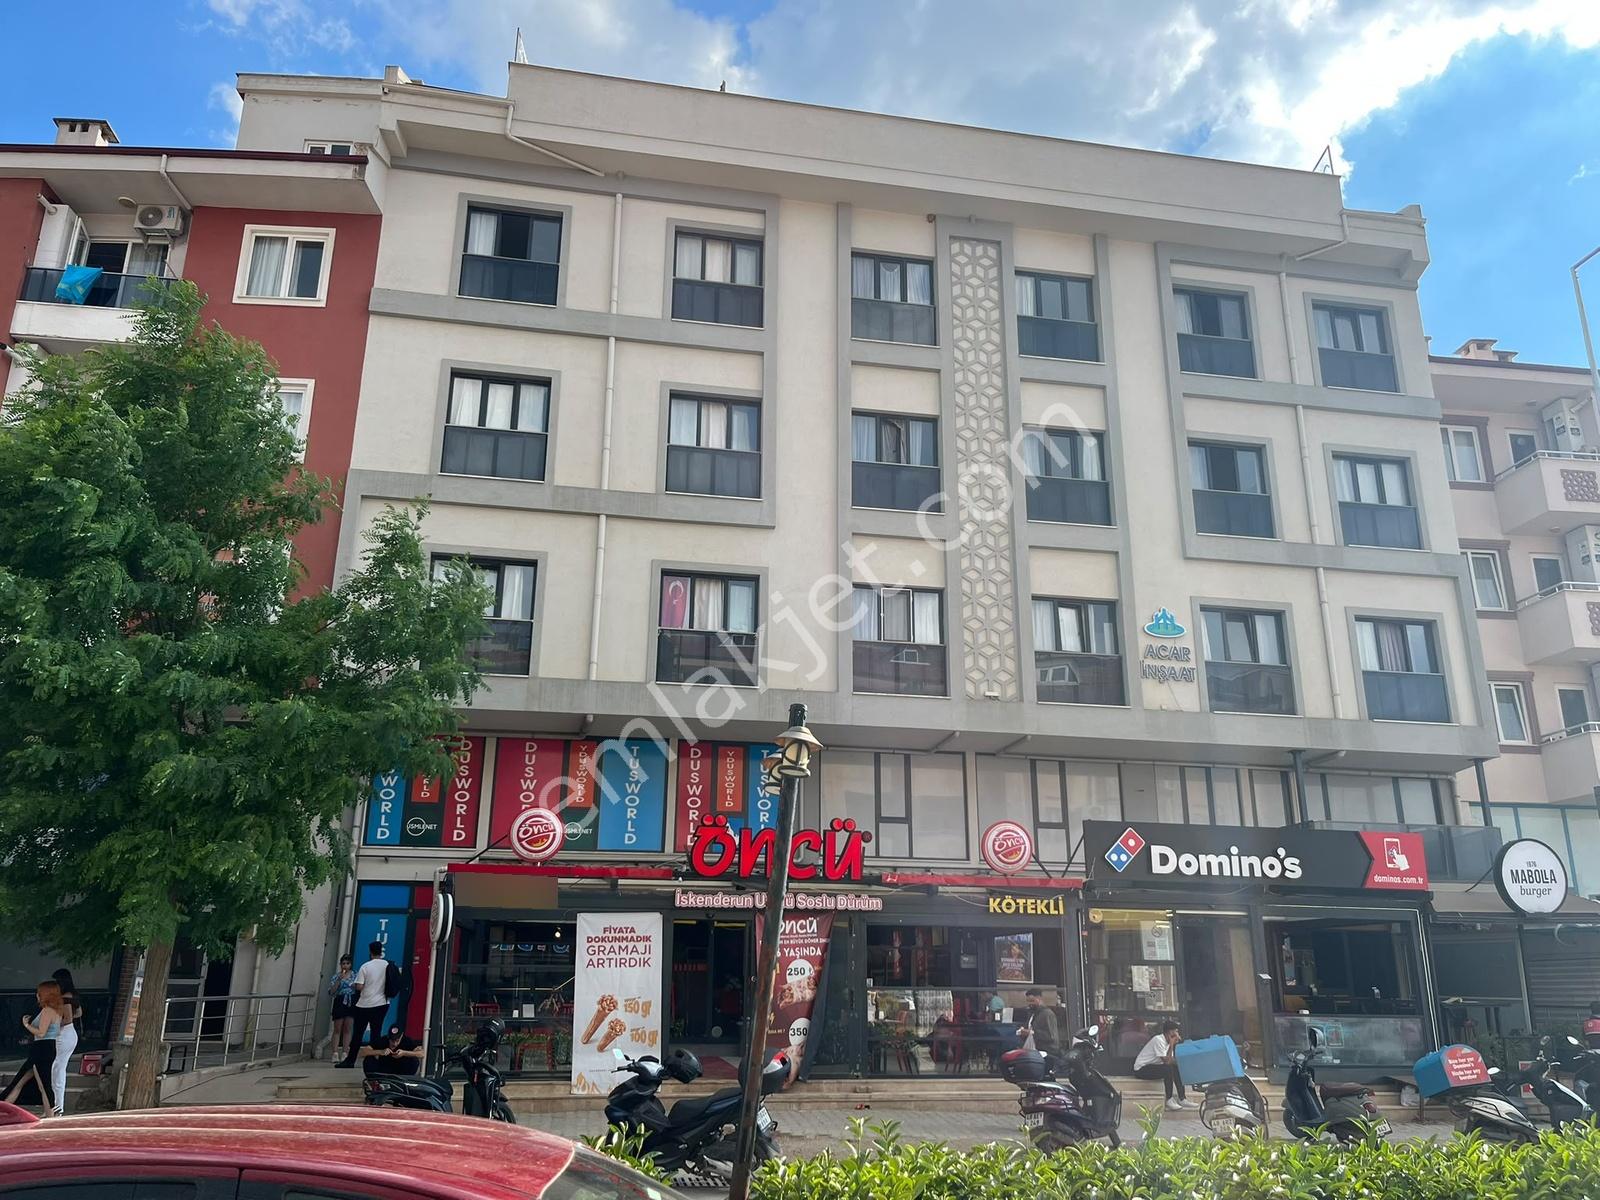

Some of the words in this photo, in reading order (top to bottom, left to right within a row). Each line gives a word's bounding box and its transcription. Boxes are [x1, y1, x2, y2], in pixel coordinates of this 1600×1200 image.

[1145, 644, 1191, 662] ACAR
[725, 751, 736, 807] YDUSWORLD
[624, 746, 642, 845] TUSWORLD
[376, 770, 398, 839] WORLD
[1150, 845, 1302, 879] Domino's
[1373, 874, 1424, 885] dominos.com.tr
[1509, 869, 1558, 885] MABOLLA
[1519, 886, 1552, 898] burger
[675, 888, 754, 908] İskenderun
[796, 892, 836, 910] Soslu
[836, 892, 882, 911] Dürüm
[988, 894, 1065, 915] KÖTEKLİ
[602, 925, 636, 934] FİYATA
[586, 935, 652, 944] DOKUNMADIK
[586, 944, 651, 956] GRAMAJI
[783, 946, 822, 959] YAŞINDA
[586, 957, 651, 969] ARTIRDIK
[787, 966, 806, 976] 250
[790, 1027, 808, 1037] 350
